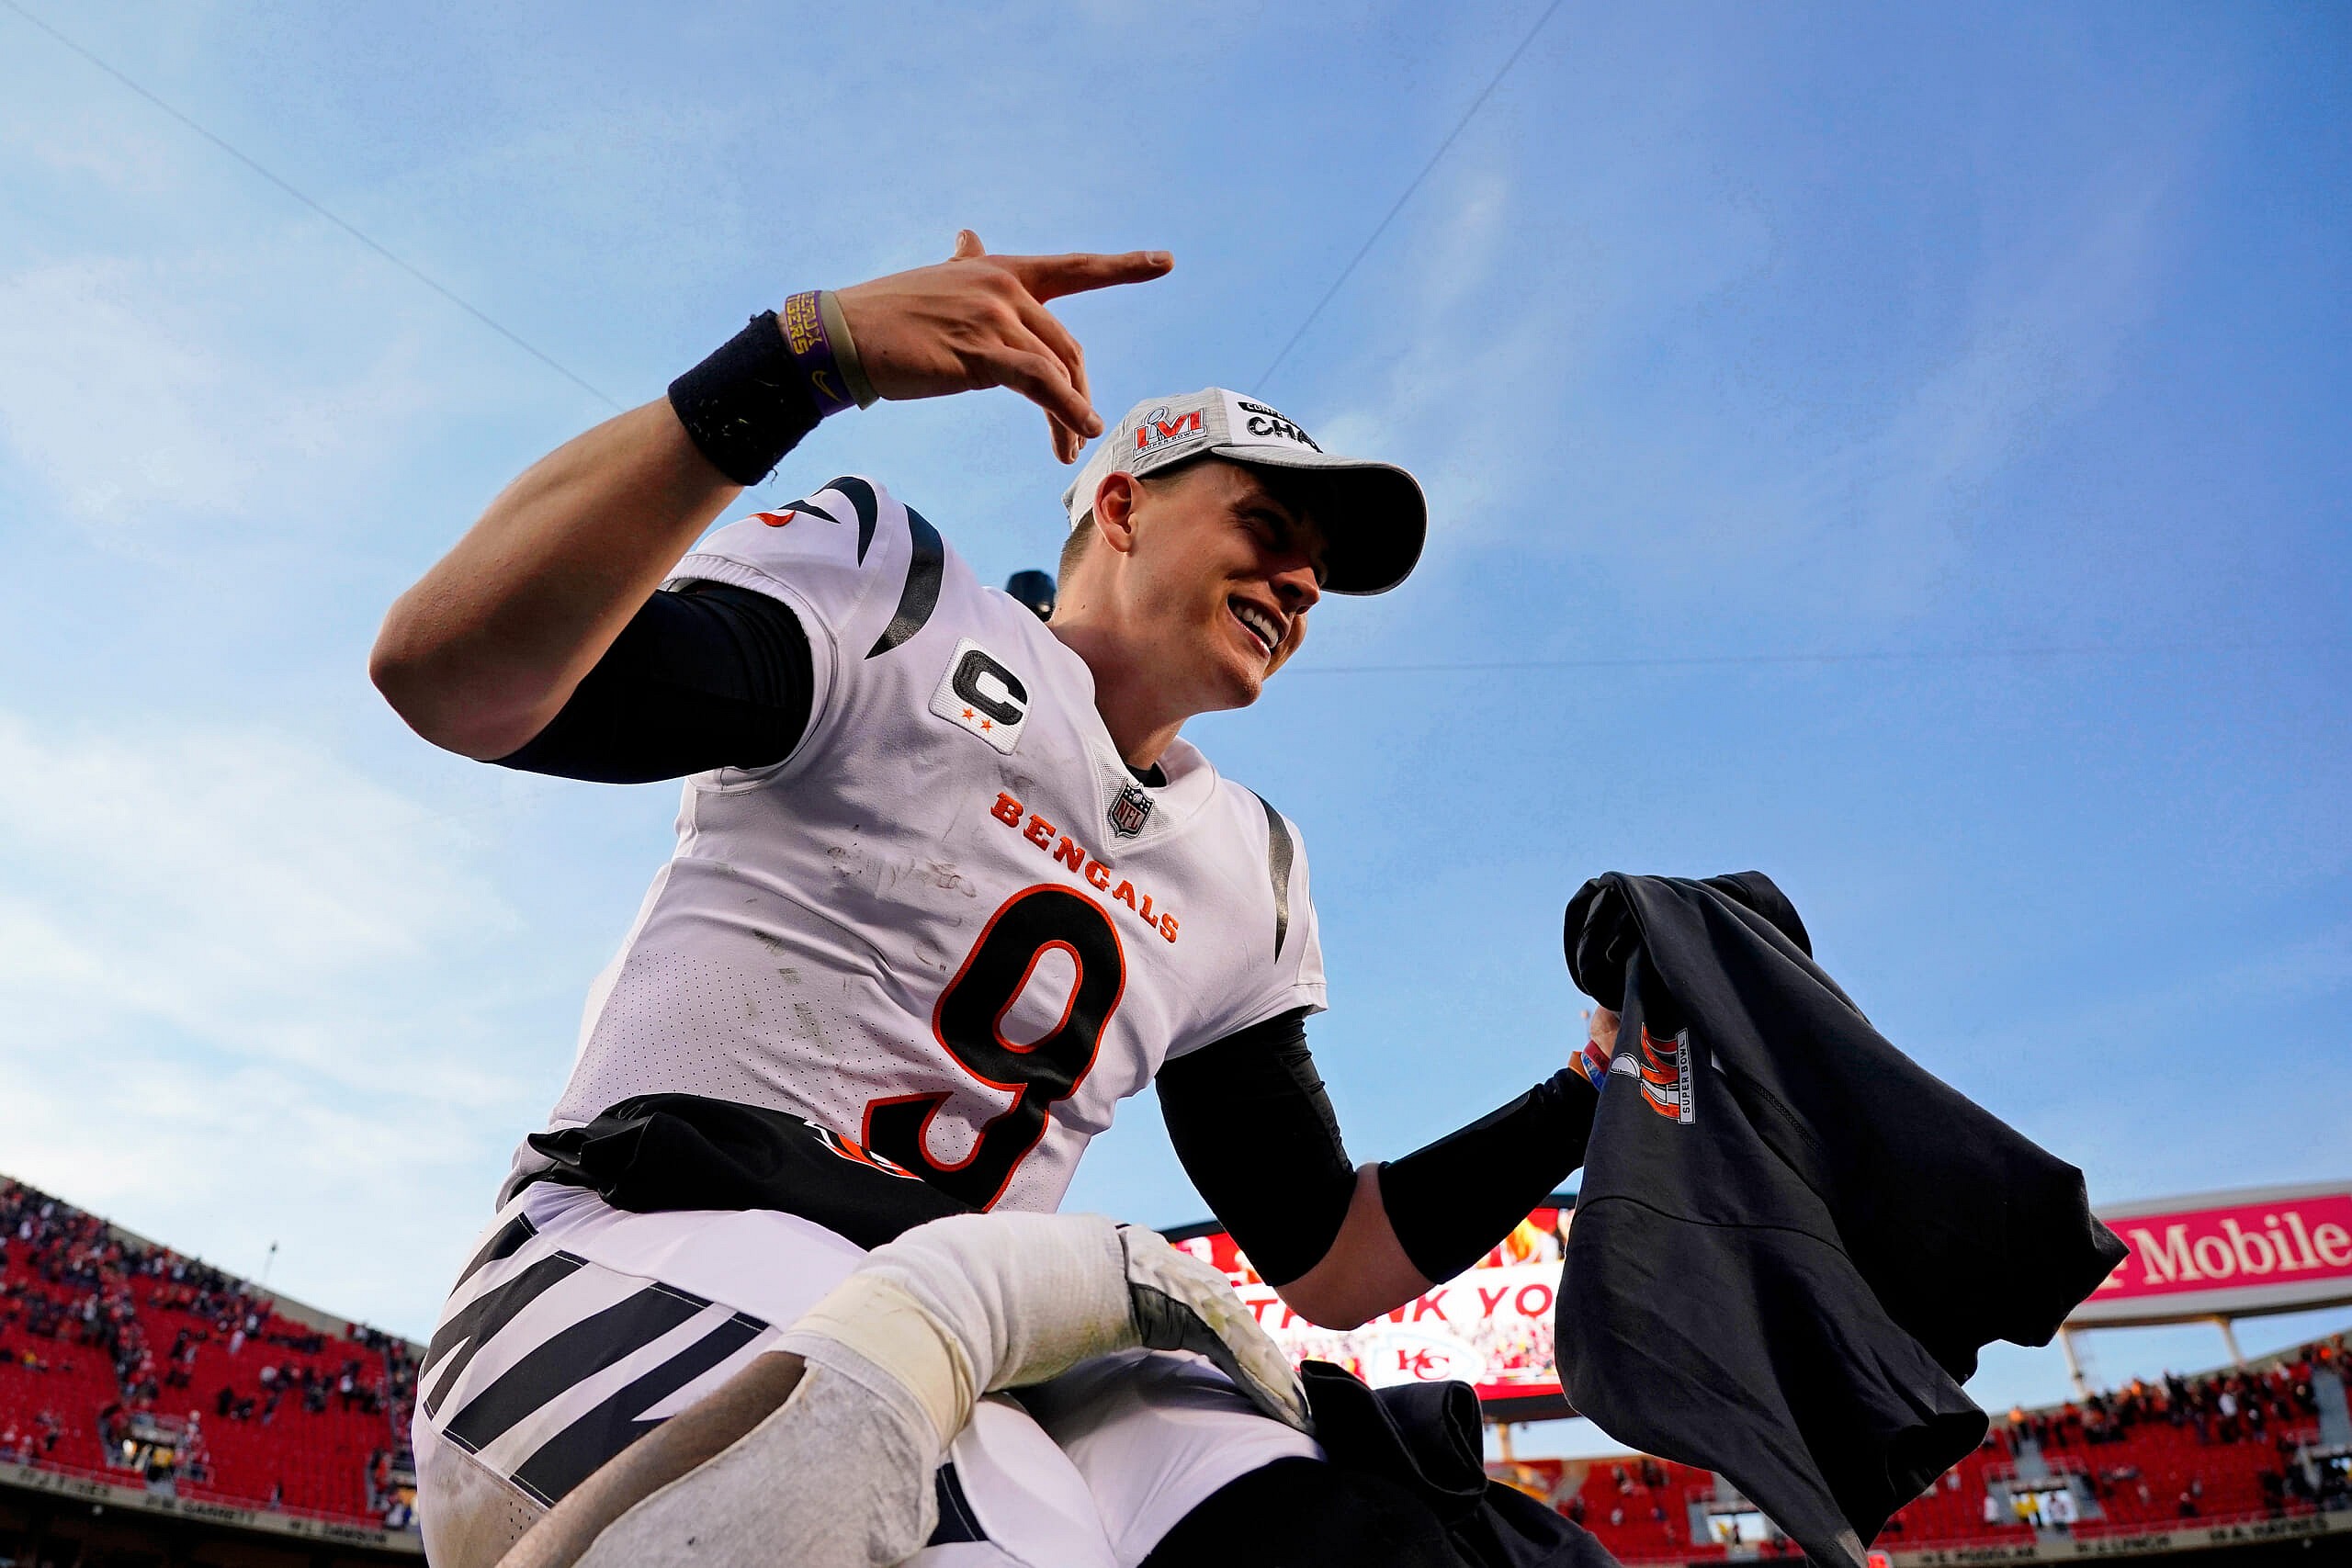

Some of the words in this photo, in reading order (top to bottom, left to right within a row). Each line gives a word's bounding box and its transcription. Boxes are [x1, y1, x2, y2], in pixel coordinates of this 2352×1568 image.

[952, 649, 1028, 726] C
[1114, 797, 1141, 831] NFL
[989, 792, 1180, 944] BENGALS
[861, 883, 1126, 1213] 9
[1679, 1039, 1689, 1074] BOWL
[1681, 1076, 1691, 1114] SUPER
[2128, 1211, 2352, 1285] Mobile
[1477, 1283, 1553, 1318] YO
[1396, 1348, 1451, 1381] KC
